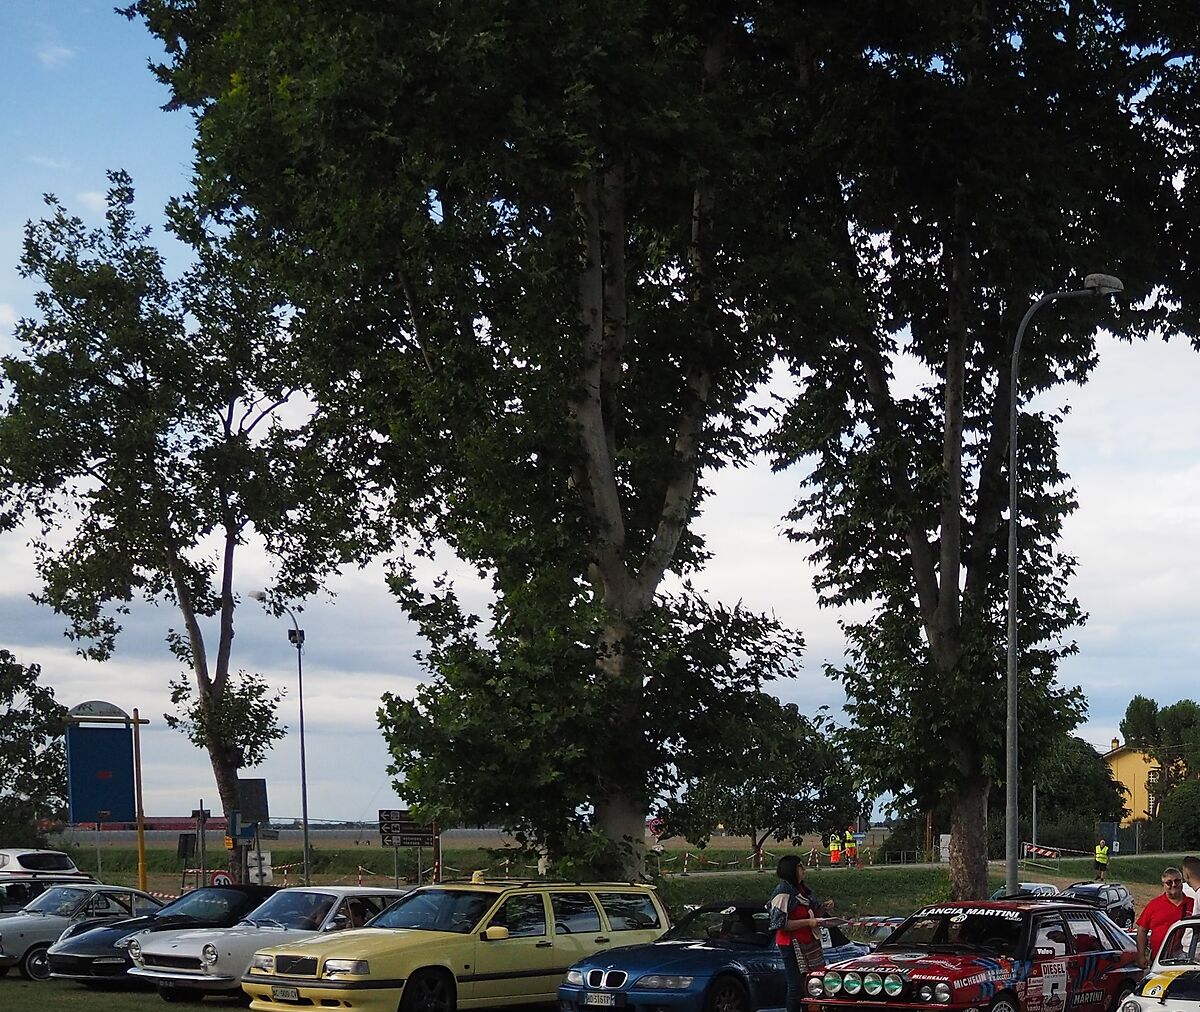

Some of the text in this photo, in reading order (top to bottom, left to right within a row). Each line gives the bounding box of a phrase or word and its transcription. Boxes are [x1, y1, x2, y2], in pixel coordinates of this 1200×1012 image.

[920, 907, 961, 916] LANCIA
[966, 908, 1020, 918] MARTINI
[857, 966, 909, 974] MARTINI
[1042, 963, 1066, 975] DIESEL
[953, 972, 987, 989] MICHELIN
[1074, 991, 1103, 1004] MARTINI
